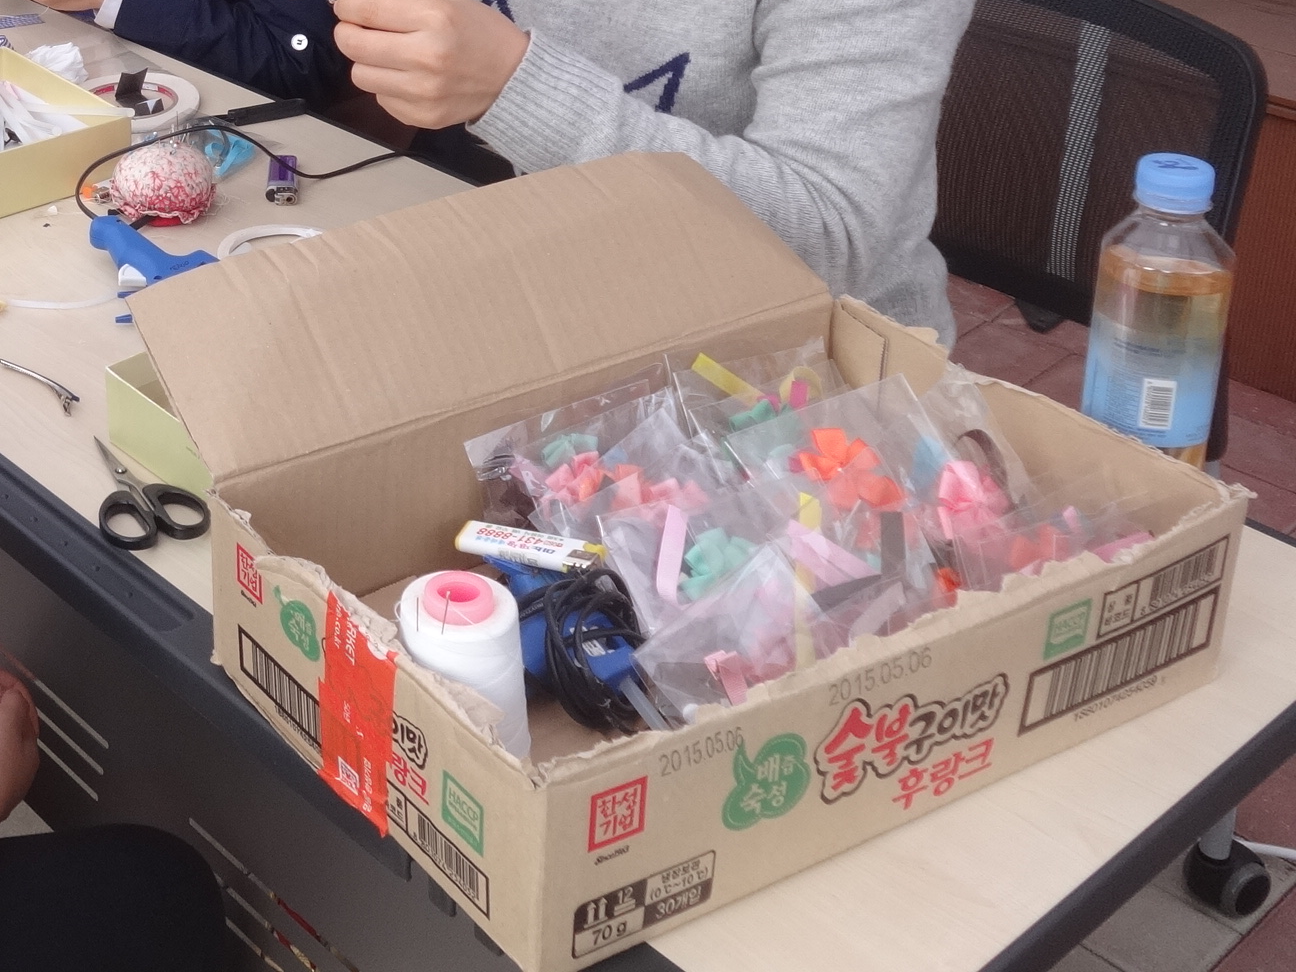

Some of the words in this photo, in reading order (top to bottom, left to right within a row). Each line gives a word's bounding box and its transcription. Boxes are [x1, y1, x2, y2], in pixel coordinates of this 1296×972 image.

[829, 648, 933, 706] 2015.05.06
[658, 726, 744, 777] 2015.05.06
[823, 684, 1001, 794] 숯불구이맛
[892, 737, 995, 810] 후랑크
[448, 785, 479, 822] HACCP
[598, 786, 639, 819] 한성
[740, 780, 788, 815] 숙성
[599, 811, 635, 837] 기업
[660, 859, 701, 884] 냉장보관
[617, 886, 634, 904] 12
[655, 885, 703, 920] 30개입
